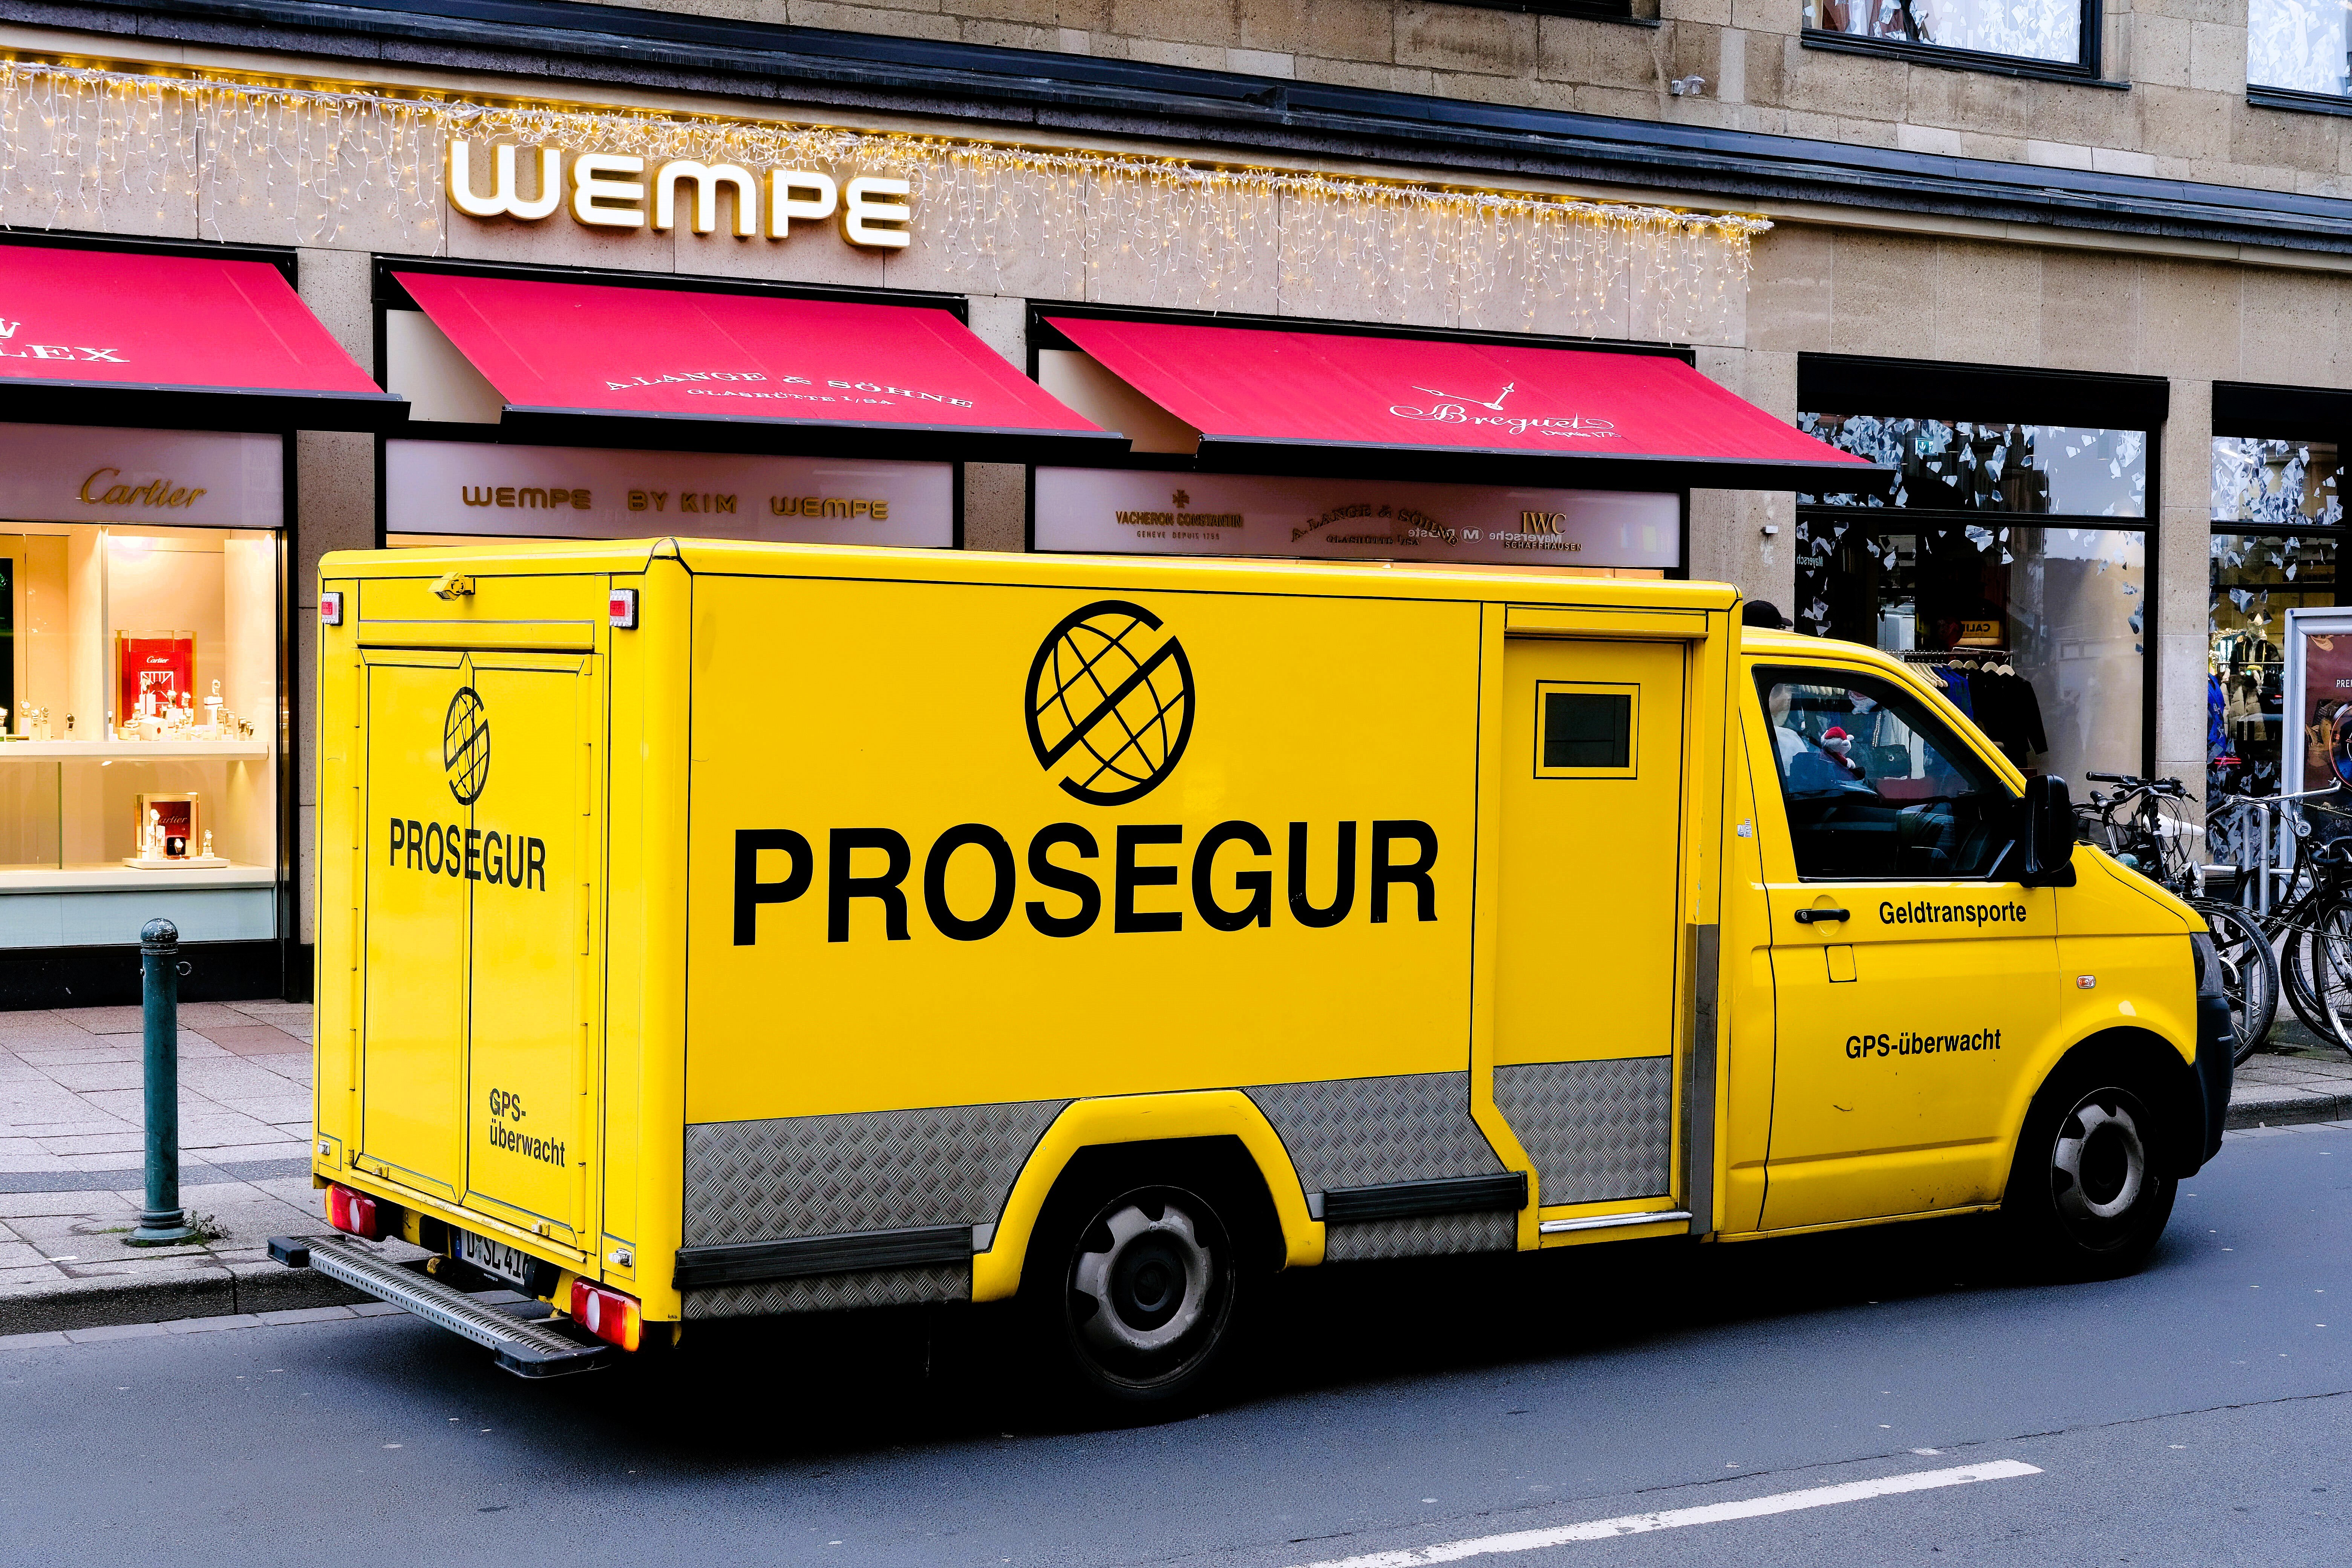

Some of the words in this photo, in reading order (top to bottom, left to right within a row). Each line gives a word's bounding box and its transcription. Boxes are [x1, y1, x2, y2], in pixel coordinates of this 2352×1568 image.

[446, 139, 910, 248] WEMPE
[687, 389, 835, 401] GLASHÜTTE
[783, 375, 812, 385] &
[827, 380, 973, 408] SÖHNE
[1390, 403, 1614, 435] Breguet
[79, 467, 207, 508] Cartier
[462, 486, 591, 510] WEMPE
[628, 490, 668, 512] BY
[682, 492, 737, 513] KIM
[771, 496, 888, 520] WEMPE
[1116, 511, 1174, 526] VACHERON
[1521, 511, 1566, 534] IWC
[1505, 542, 1582, 551] SCHAFFHAUSEN
[158, 815, 187, 824] artier
[390, 818, 545, 892] PROSEGUR
[733, 819, 1438, 945] PROSEGUR
[1879, 901, 2027, 927] Geldtransporte
[1846, 1028, 2001, 1059] GPS-überwacht
[490, 1089, 526, 1121] GPS-
[490, 1118, 565, 1167] überwacht
